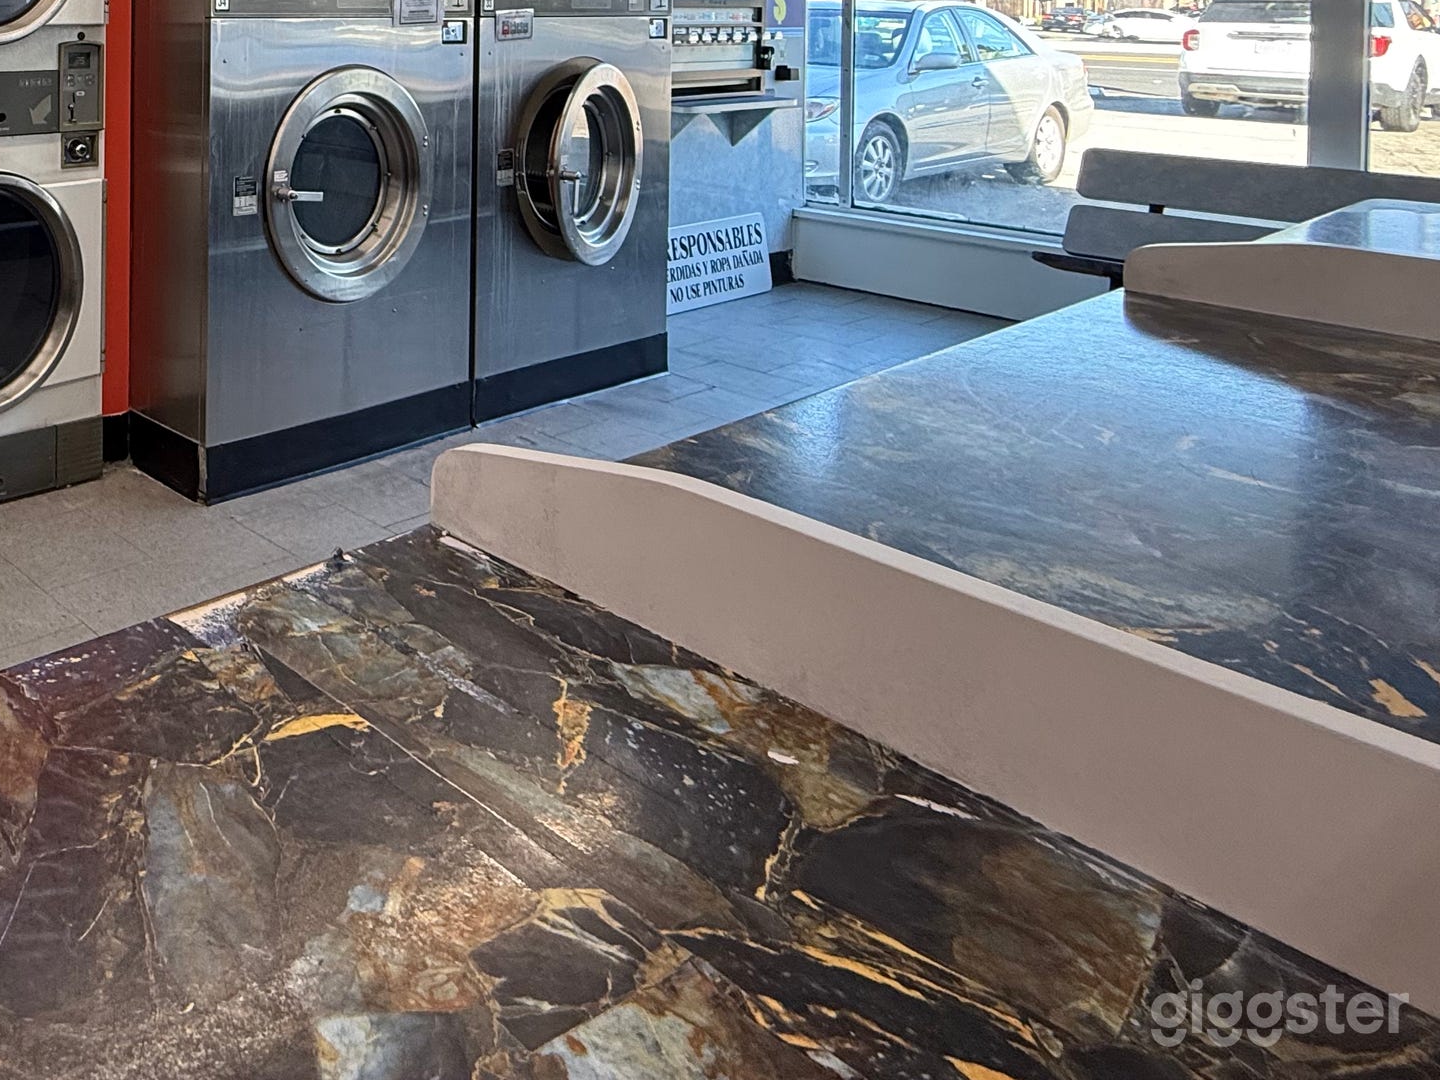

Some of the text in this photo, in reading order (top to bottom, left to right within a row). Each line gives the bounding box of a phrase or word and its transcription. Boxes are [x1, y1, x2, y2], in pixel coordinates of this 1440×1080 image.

[703, 260, 709, 276] Y
[710, 256, 731, 274] ROPA
[732, 249, 765, 269] DAÑADA
[670, 273, 745, 304] NO USE PINTURAS
